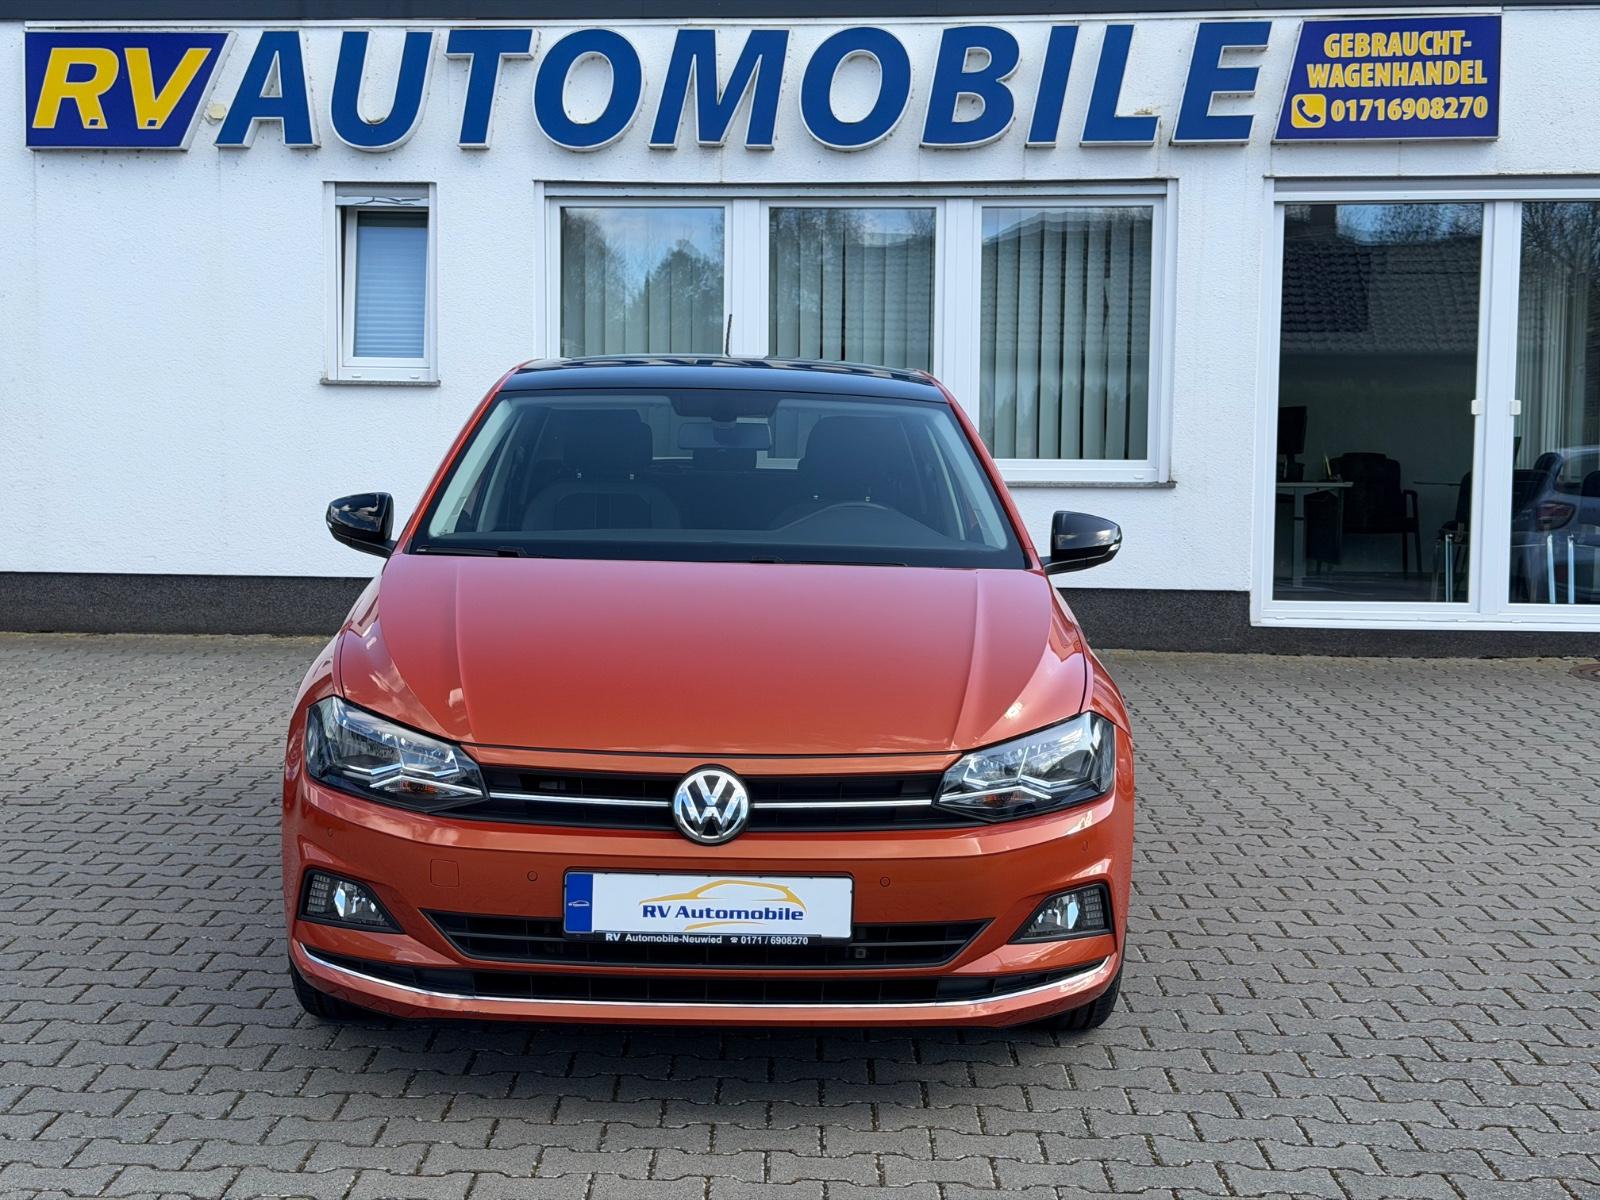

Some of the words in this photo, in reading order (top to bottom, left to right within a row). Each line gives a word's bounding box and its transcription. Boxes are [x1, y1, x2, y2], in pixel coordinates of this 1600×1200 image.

[1323, 30, 1472, 58] GEBRAUCHT-
[215, 22, 1271, 152] AUTOMOBILE
[1306, 60, 1488, 89] WAGENHANDEL
[1330, 95, 1489, 122] 01716908270
[642, 905, 671, 918] RV
[675, 905, 804, 921] Automobile
[605, 933, 621, 942] RV
[625, 934, 723, 944] Automobile-Neuwied
[740, 936, 763, 944] 0171
[770, 936, 809, 945] 6908270
